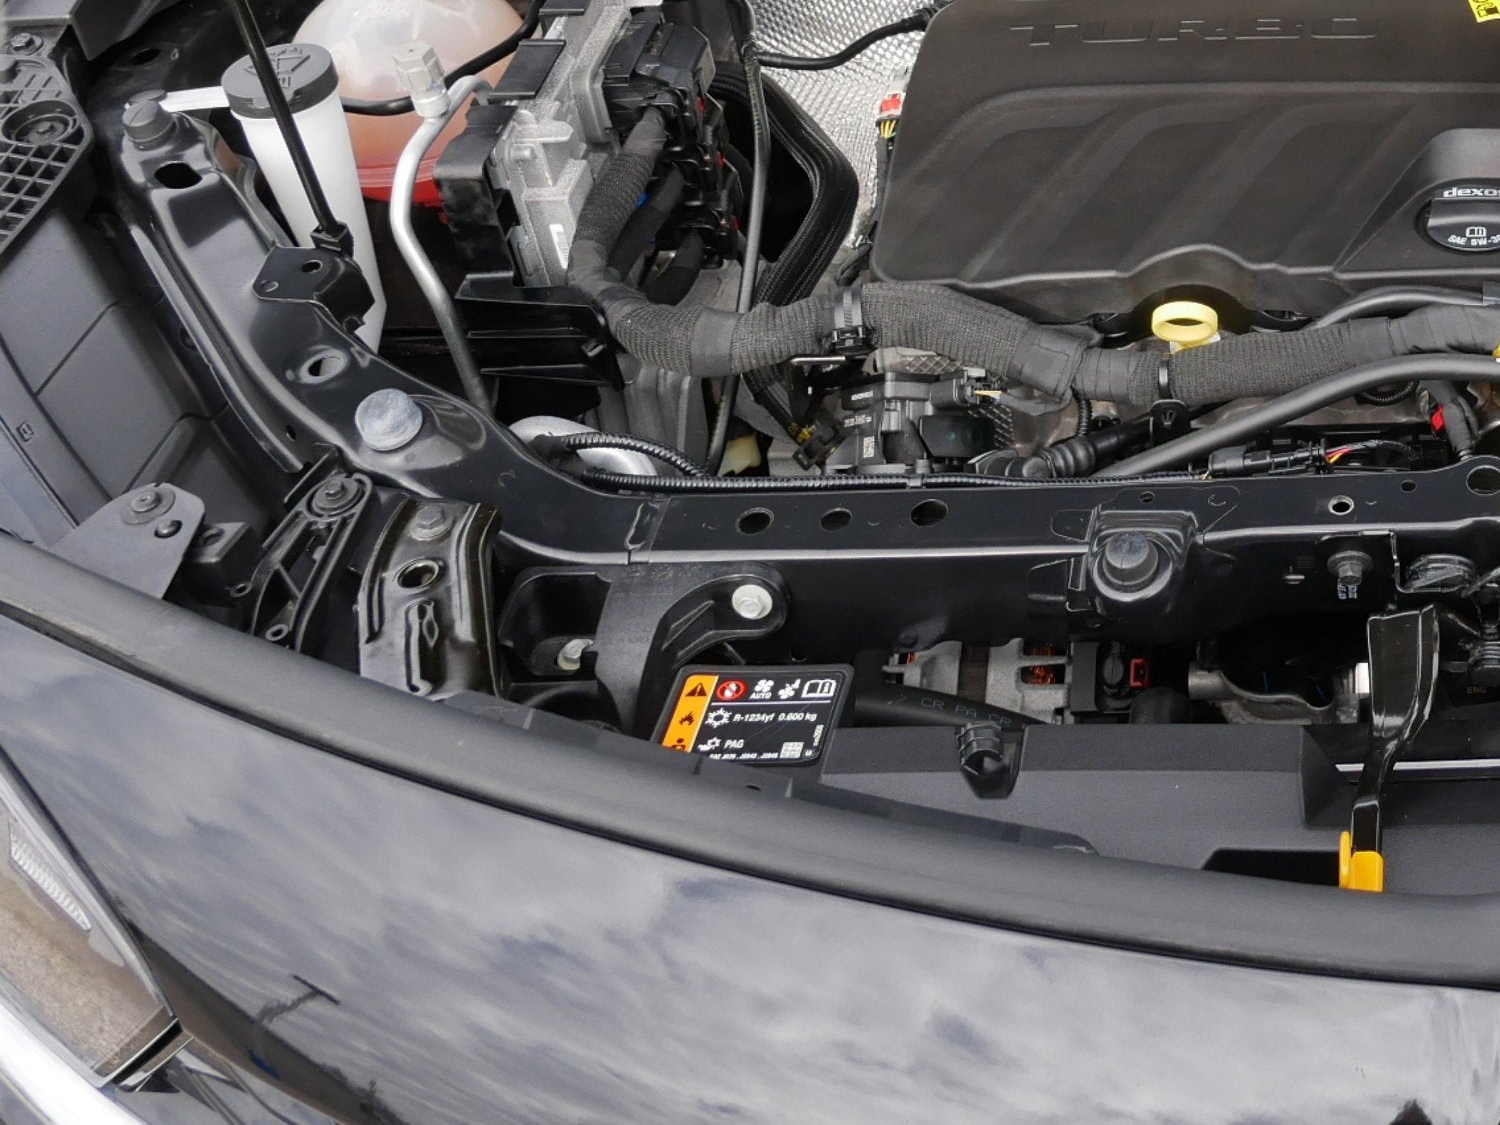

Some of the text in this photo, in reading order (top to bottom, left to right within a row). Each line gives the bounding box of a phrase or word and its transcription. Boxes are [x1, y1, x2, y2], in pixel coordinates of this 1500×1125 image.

[1009, 17, 1378, 46] TURBO
[1447, 235, 1467, 245] SAE
[733, 712, 776, 723] R-1234yf
[805, 711, 818, 723] kg
[723, 739, 745, 749] PAG
